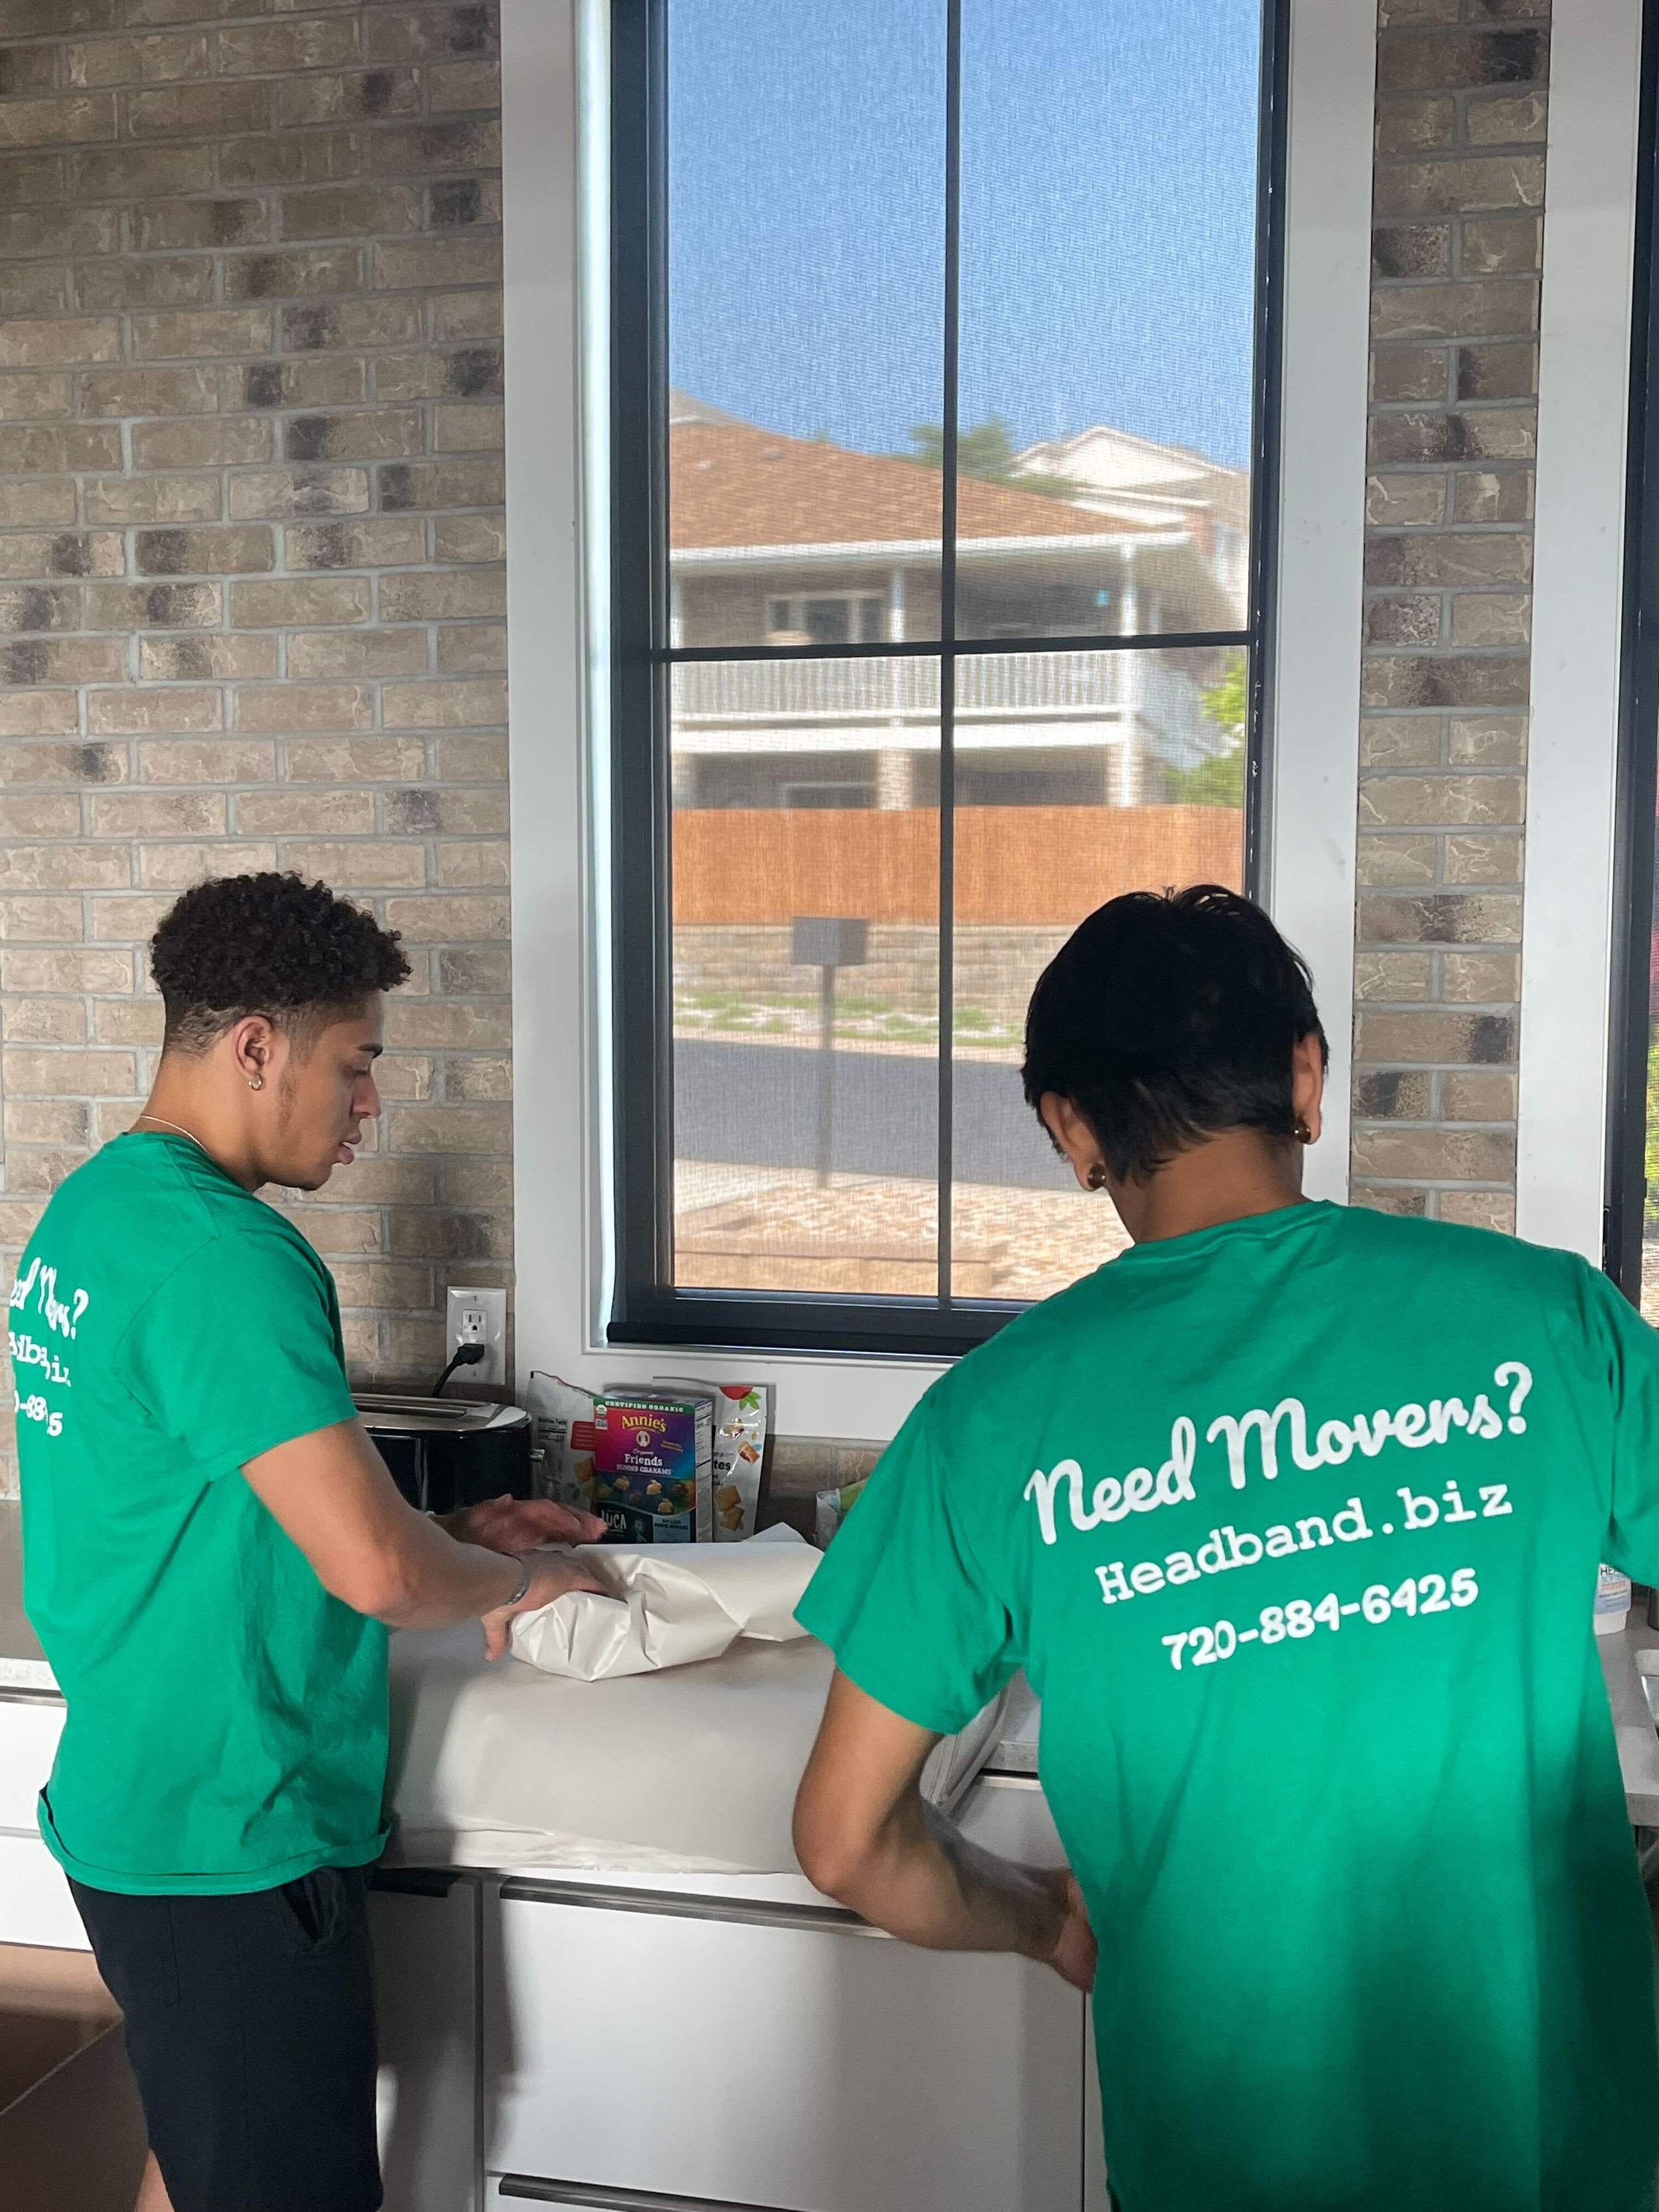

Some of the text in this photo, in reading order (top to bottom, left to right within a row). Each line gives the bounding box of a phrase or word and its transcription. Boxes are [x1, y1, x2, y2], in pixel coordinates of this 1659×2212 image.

[605, 1400, 647, 1410] CERTIFIED
[621, 1414, 667, 1433] Annie's
[624, 1453, 663, 1467] Friends
[1023, 1361, 1534, 1546] Need Movers?
[1094, 1479, 1514, 1605] Headband.biz
[1161, 1567, 1479, 1671] 720-884-6425
